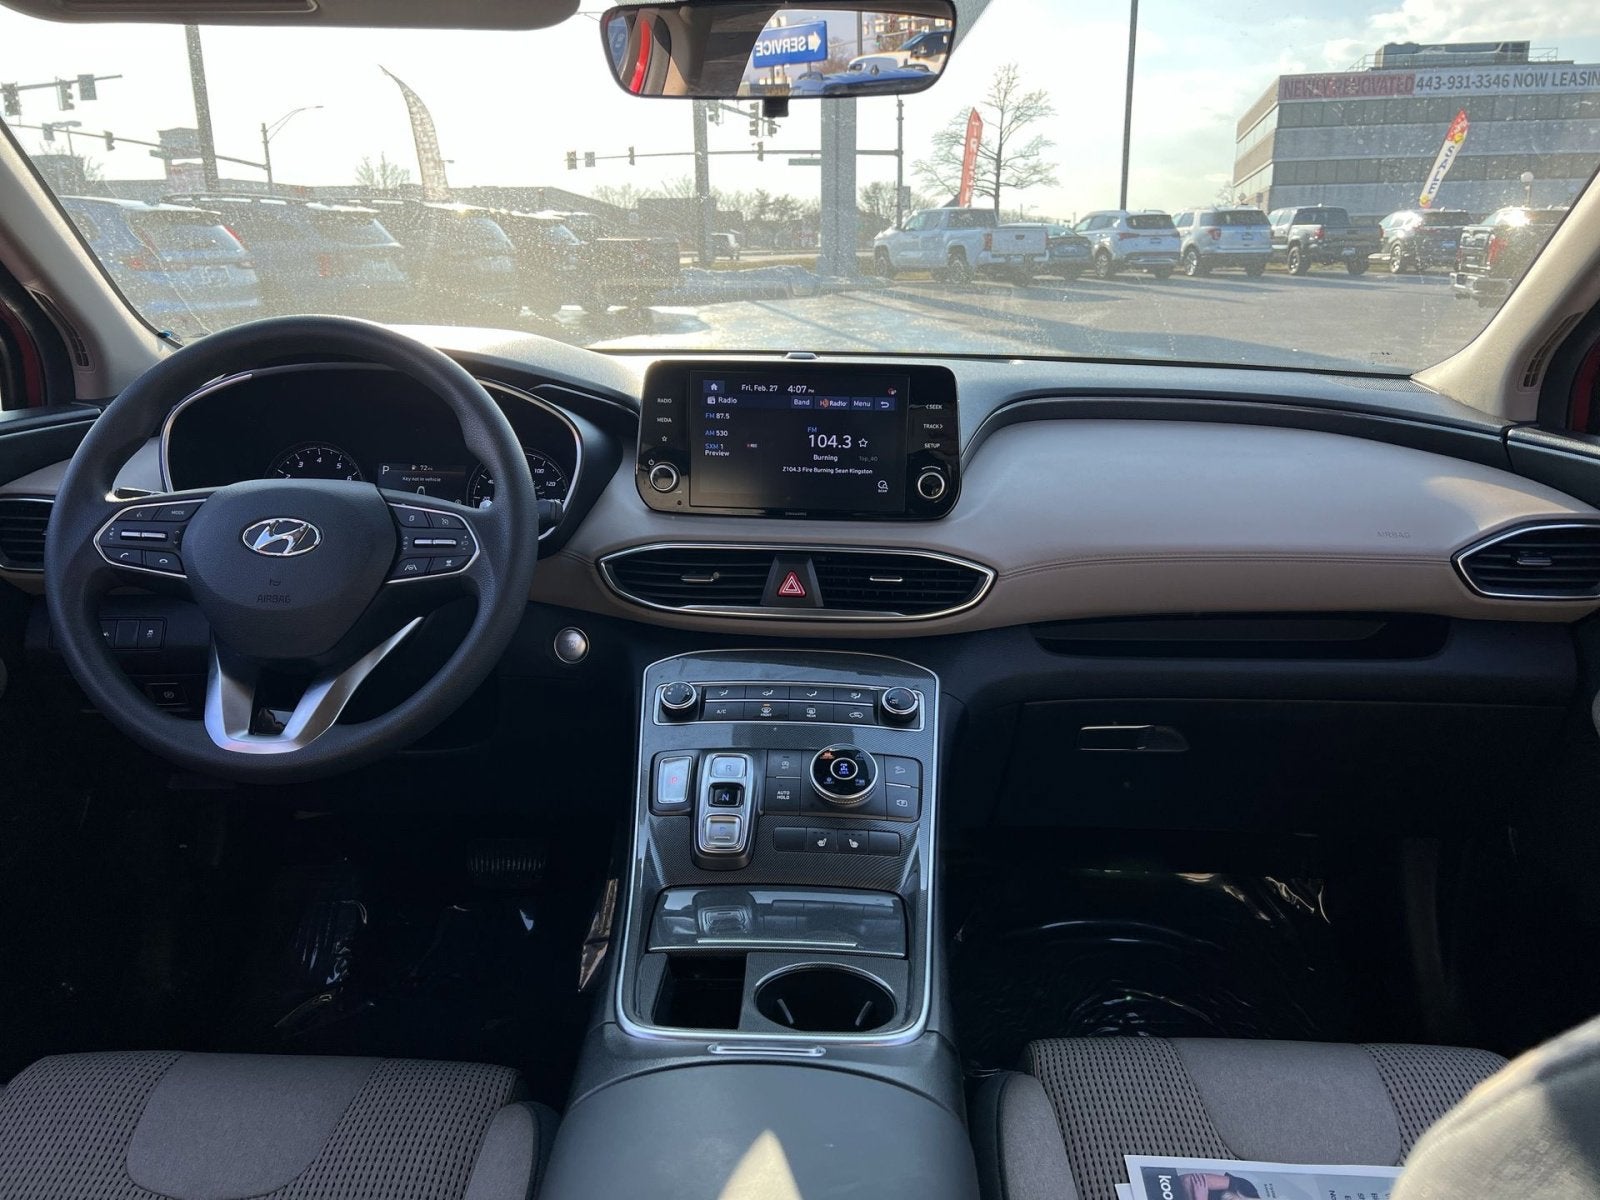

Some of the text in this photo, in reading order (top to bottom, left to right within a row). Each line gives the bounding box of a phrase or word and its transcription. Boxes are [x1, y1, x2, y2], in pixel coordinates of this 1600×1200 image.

[1416, 73, 1510, 91] 443-931-3346
[1513, 72, 1548, 87] NOW
[1427, 145, 1456, 195] SALE
[754, 384, 769, 392] Feb.
[769, 384, 778, 392] 27
[787, 384, 806, 393] 4:07
[793, 398, 810, 406] Band
[808, 434, 852, 448] 104.3
[813, 454, 838, 462] Burning
[382, 465, 389, 474] P
[256, 594, 292, 603] AIRBAG
[722, 793, 729, 801] N
